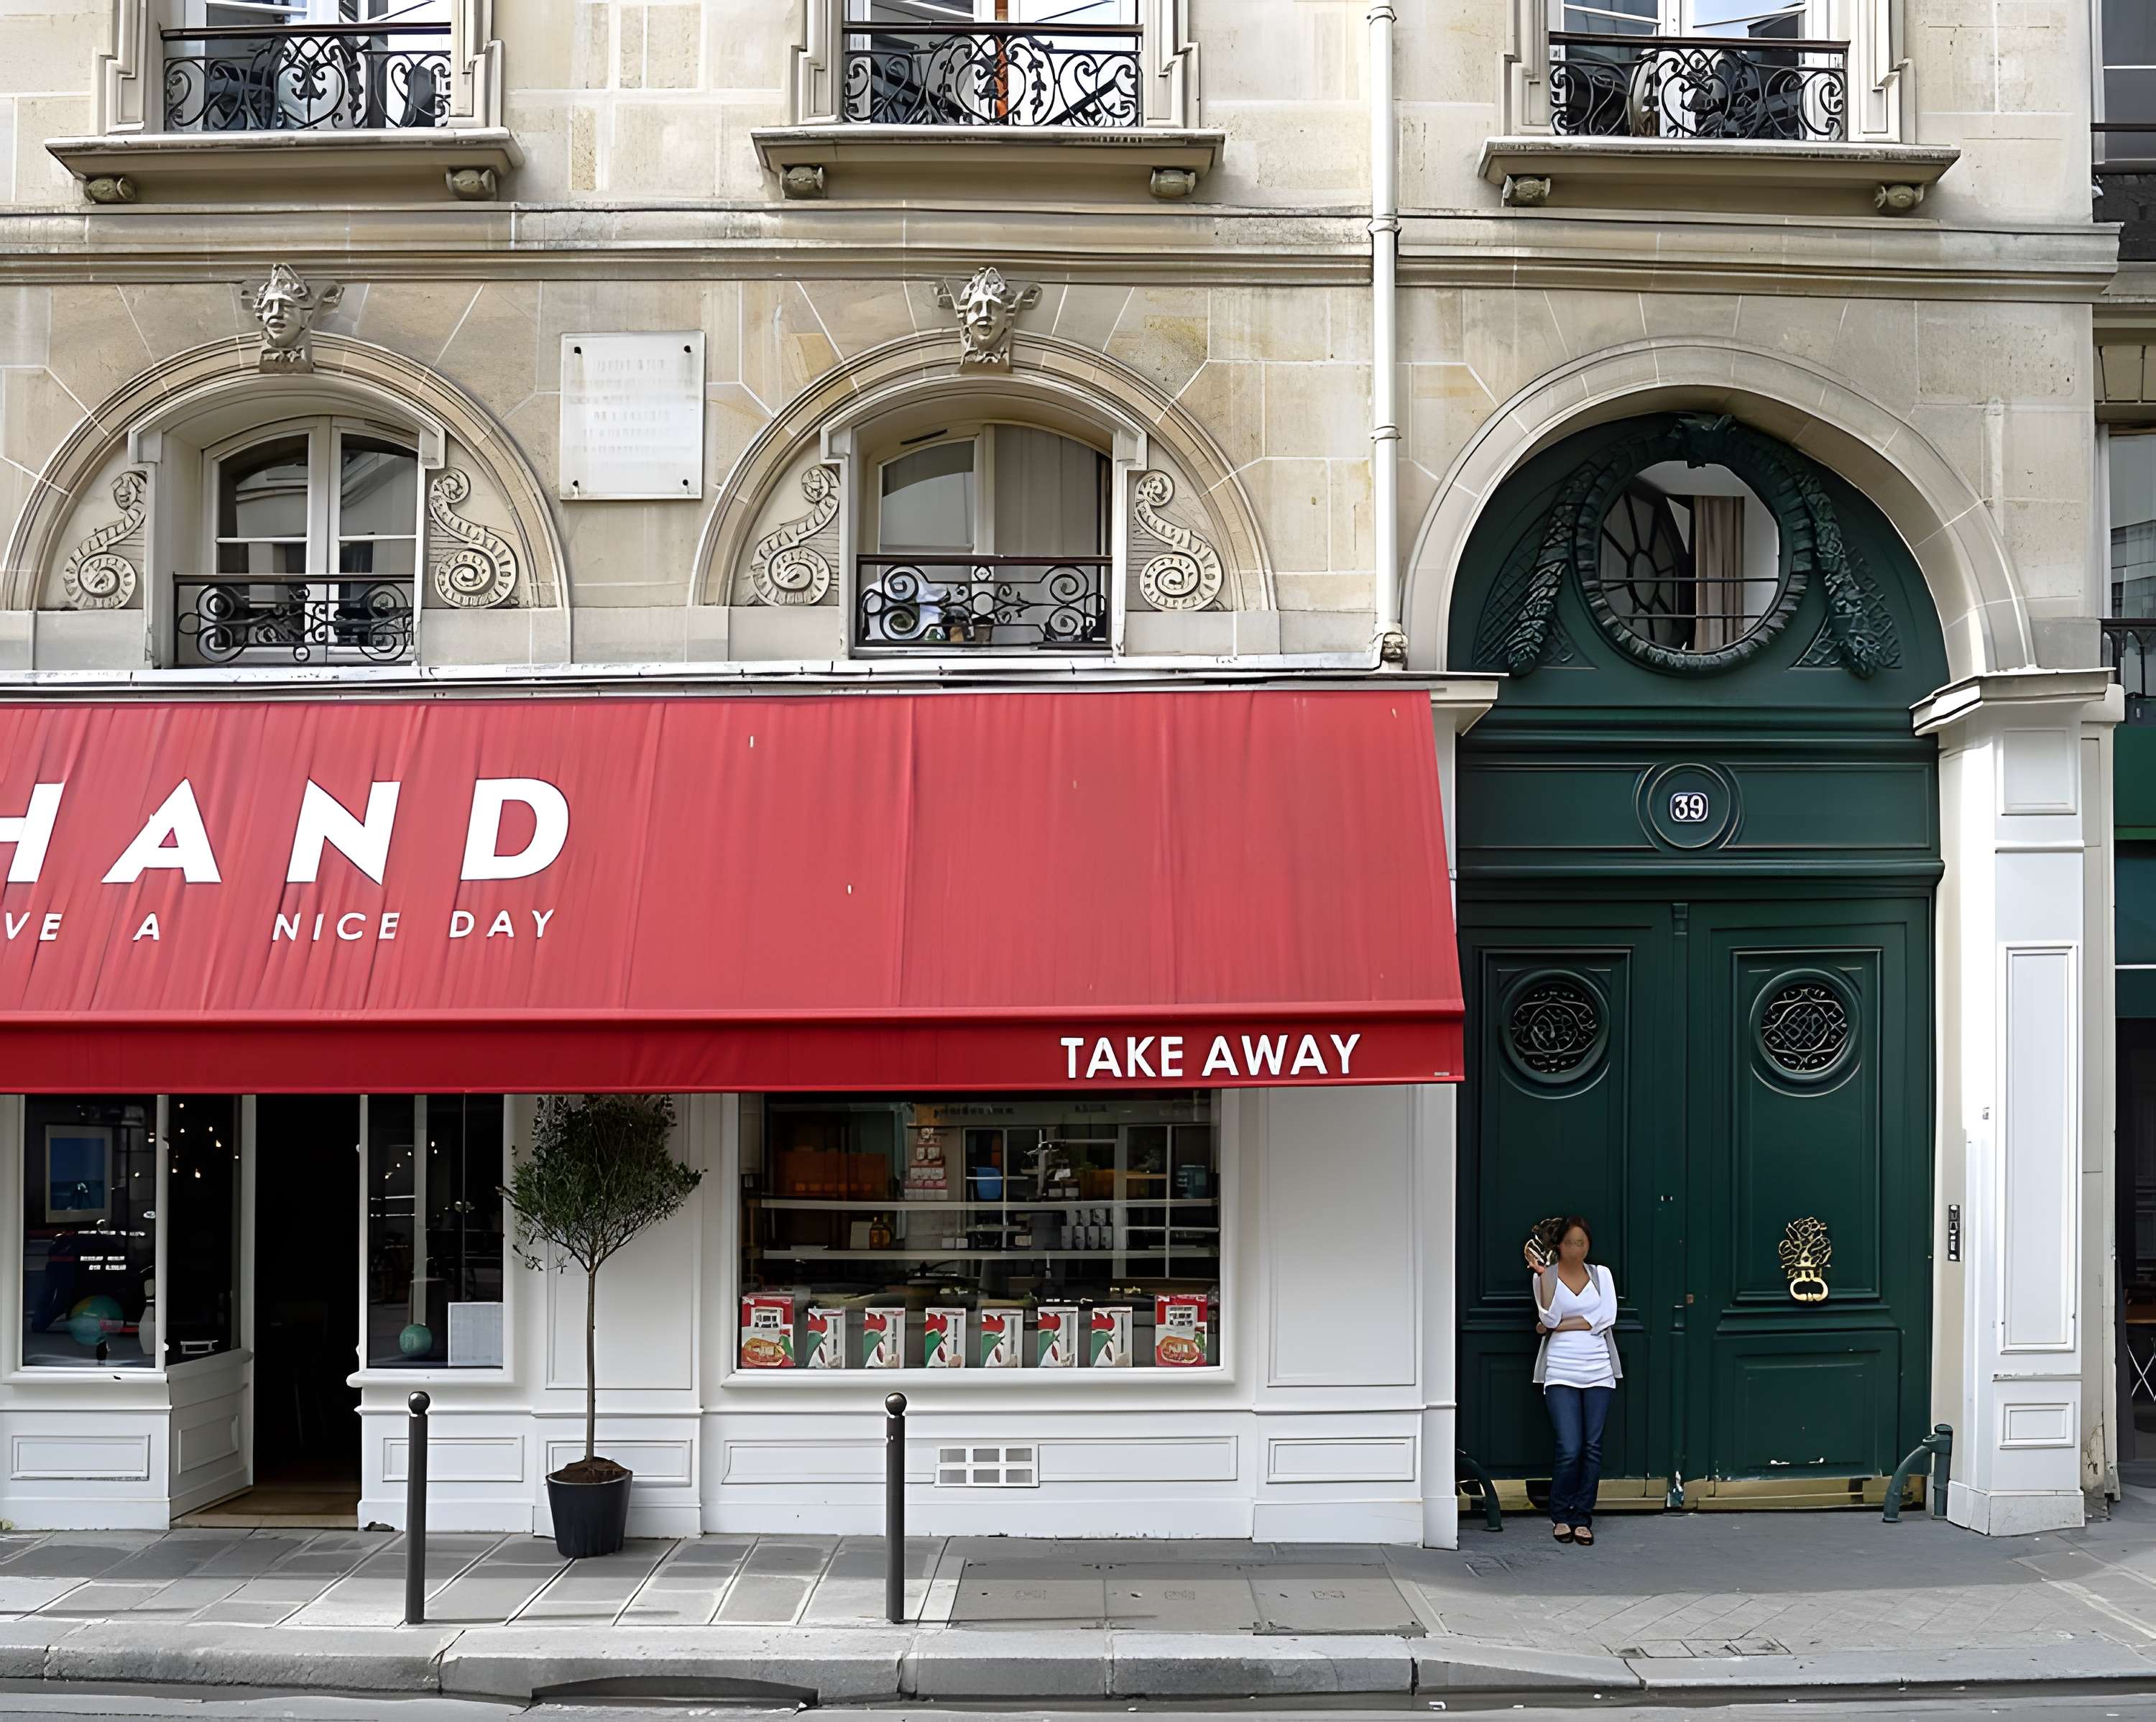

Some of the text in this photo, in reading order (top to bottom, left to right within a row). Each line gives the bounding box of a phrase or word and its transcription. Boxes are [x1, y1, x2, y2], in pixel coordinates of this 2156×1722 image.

[1676, 795, 1704, 819] 39
[5, 909, 555, 941] VE A NICE DAY
[1060, 1033, 1360, 1079] TAKE AWAY
